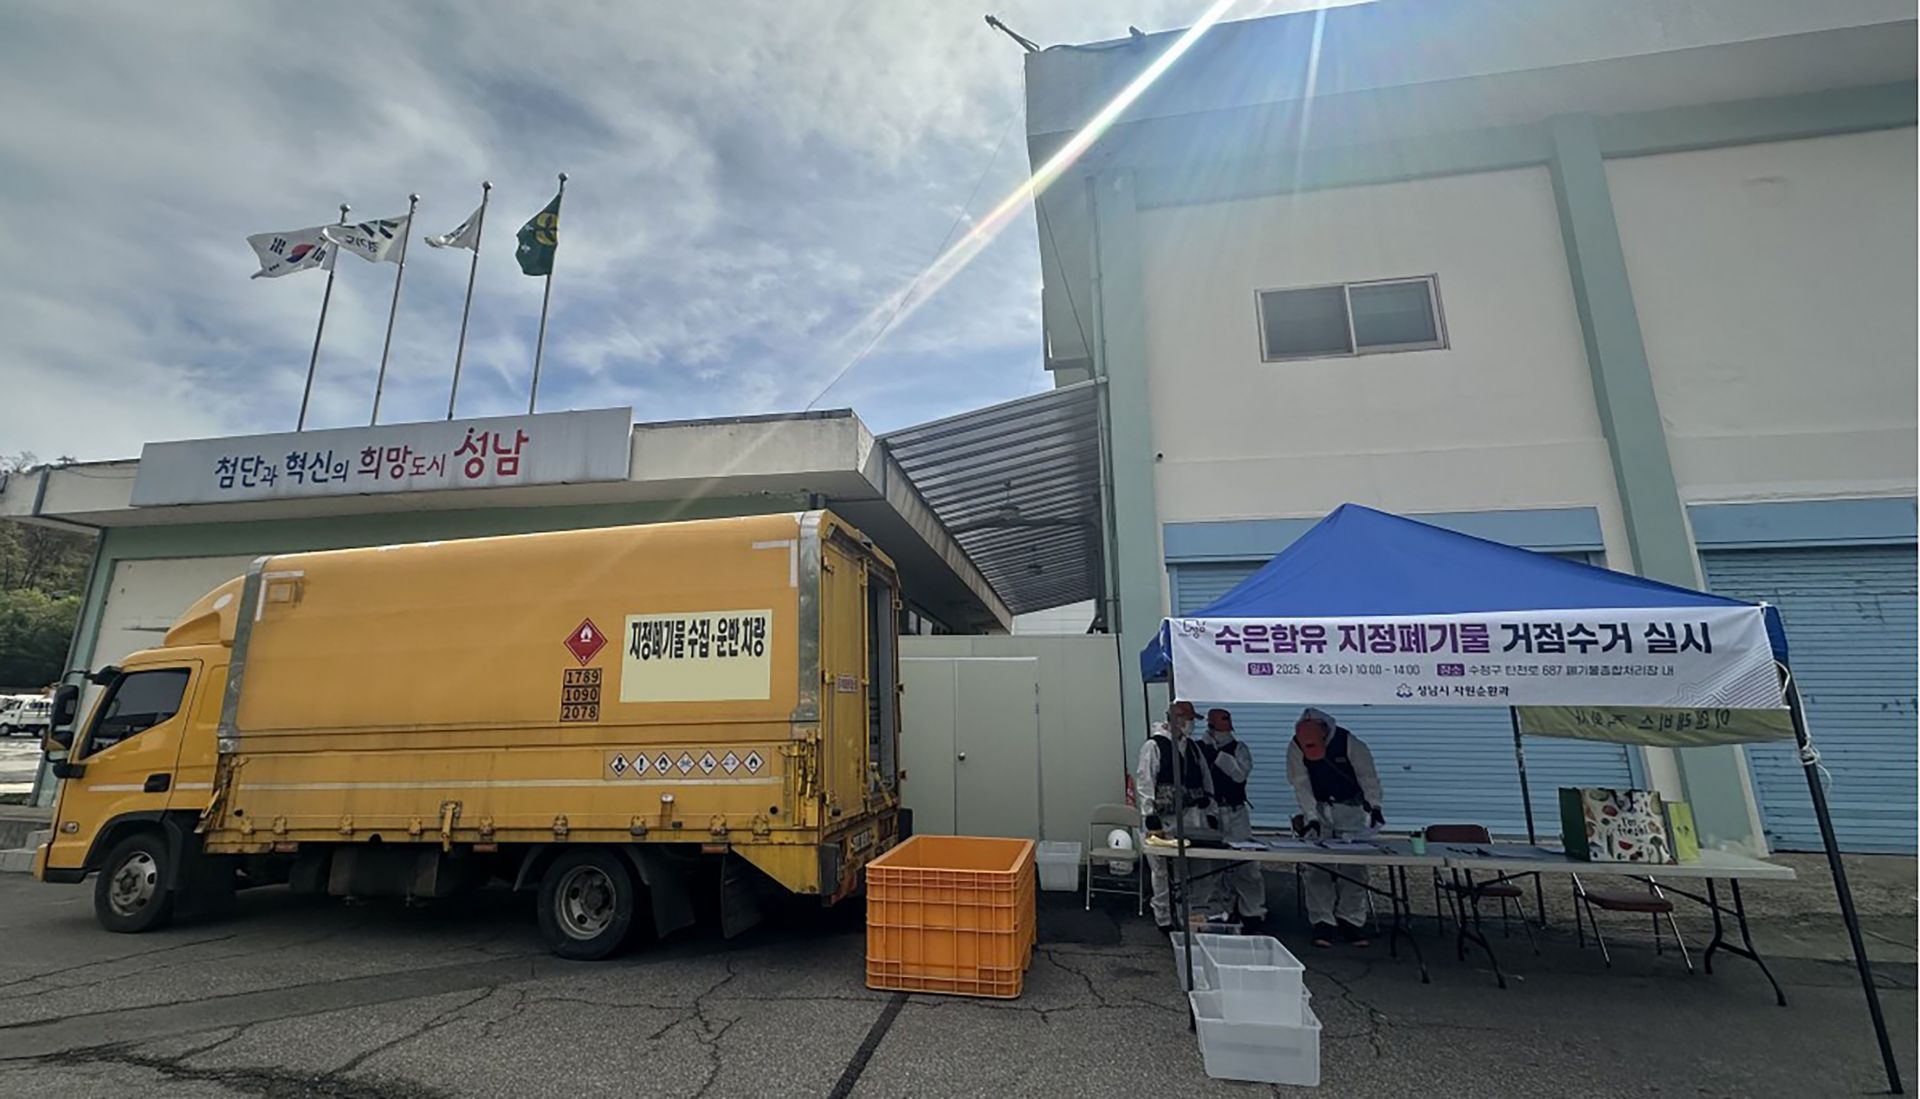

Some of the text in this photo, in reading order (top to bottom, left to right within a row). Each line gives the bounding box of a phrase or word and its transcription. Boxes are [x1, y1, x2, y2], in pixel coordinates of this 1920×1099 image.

[214, 426, 529, 488] 첨단과 혁신의 희망도시 성남
[629, 620, 686, 660] 지정폐기물
[741, 616, 766, 657] 차량
[1214, 623, 1328, 654] 수은함유
[1337, 622, 1491, 654] 지정폐기물
[1500, 622, 1633, 654] 거점수거
[1643, 622, 1713, 654] 실시
[566, 670, 599, 684] 1789
[1250, 664, 1272, 675] 일시
[1468, 665, 1502, 676] 수정구
[1542, 665, 1562, 676] 687
[1661, 665, 1675, 676] 내
[564, 687, 598, 702] 1090
[1417, 685, 1509, 697] 성남시 자원순환과
[562, 705, 597, 719] 2078
